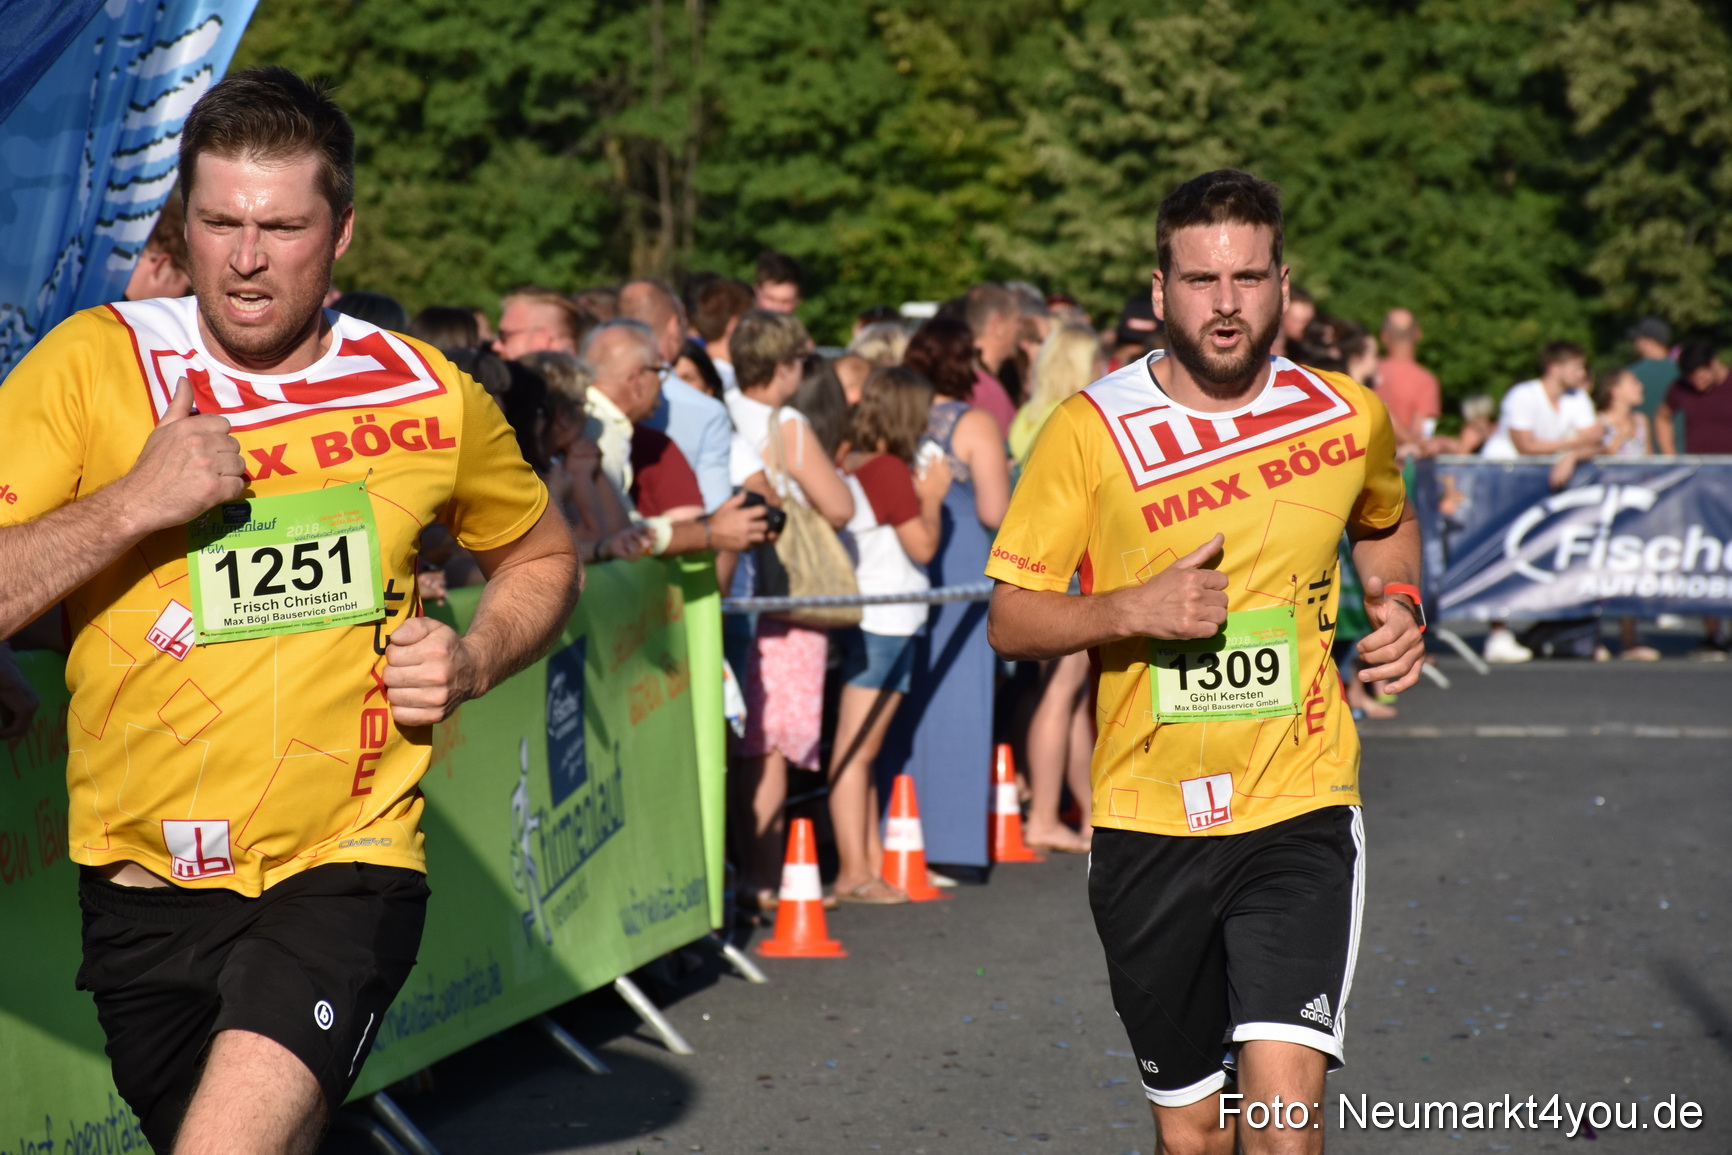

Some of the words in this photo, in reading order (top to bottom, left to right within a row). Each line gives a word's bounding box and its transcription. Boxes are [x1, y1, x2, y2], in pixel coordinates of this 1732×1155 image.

[311, 414, 456, 469] BÖGL
[1141, 473, 1251, 533] MAX
[1258, 433, 1366, 489] BÖGL
[286, 523, 320, 538] 2018
[1553, 524, 1732, 572] Fisch
[215, 536, 352, 600] 1251
[223, 617, 244, 627] Max
[247, 614, 270, 625] Bögl
[273, 608, 326, 621] Bauservice
[329, 601, 358, 614] GmbH
[234, 599, 279, 614] Frisch
[284, 591, 348, 609] Christian
[1169, 648, 1280, 691] 1309
[1174, 704, 1190, 712] Max
[1192, 702, 1210, 713] Bögl
[1212, 701, 1254, 711] Bauservice
[1256, 699, 1279, 709] GmbH
[1190, 692, 1217, 703] Göhl
[1220, 690, 1264, 702] Kersten
[1300, 1008, 1333, 1029] adidas
[1139, 1058, 1159, 1074] KG
